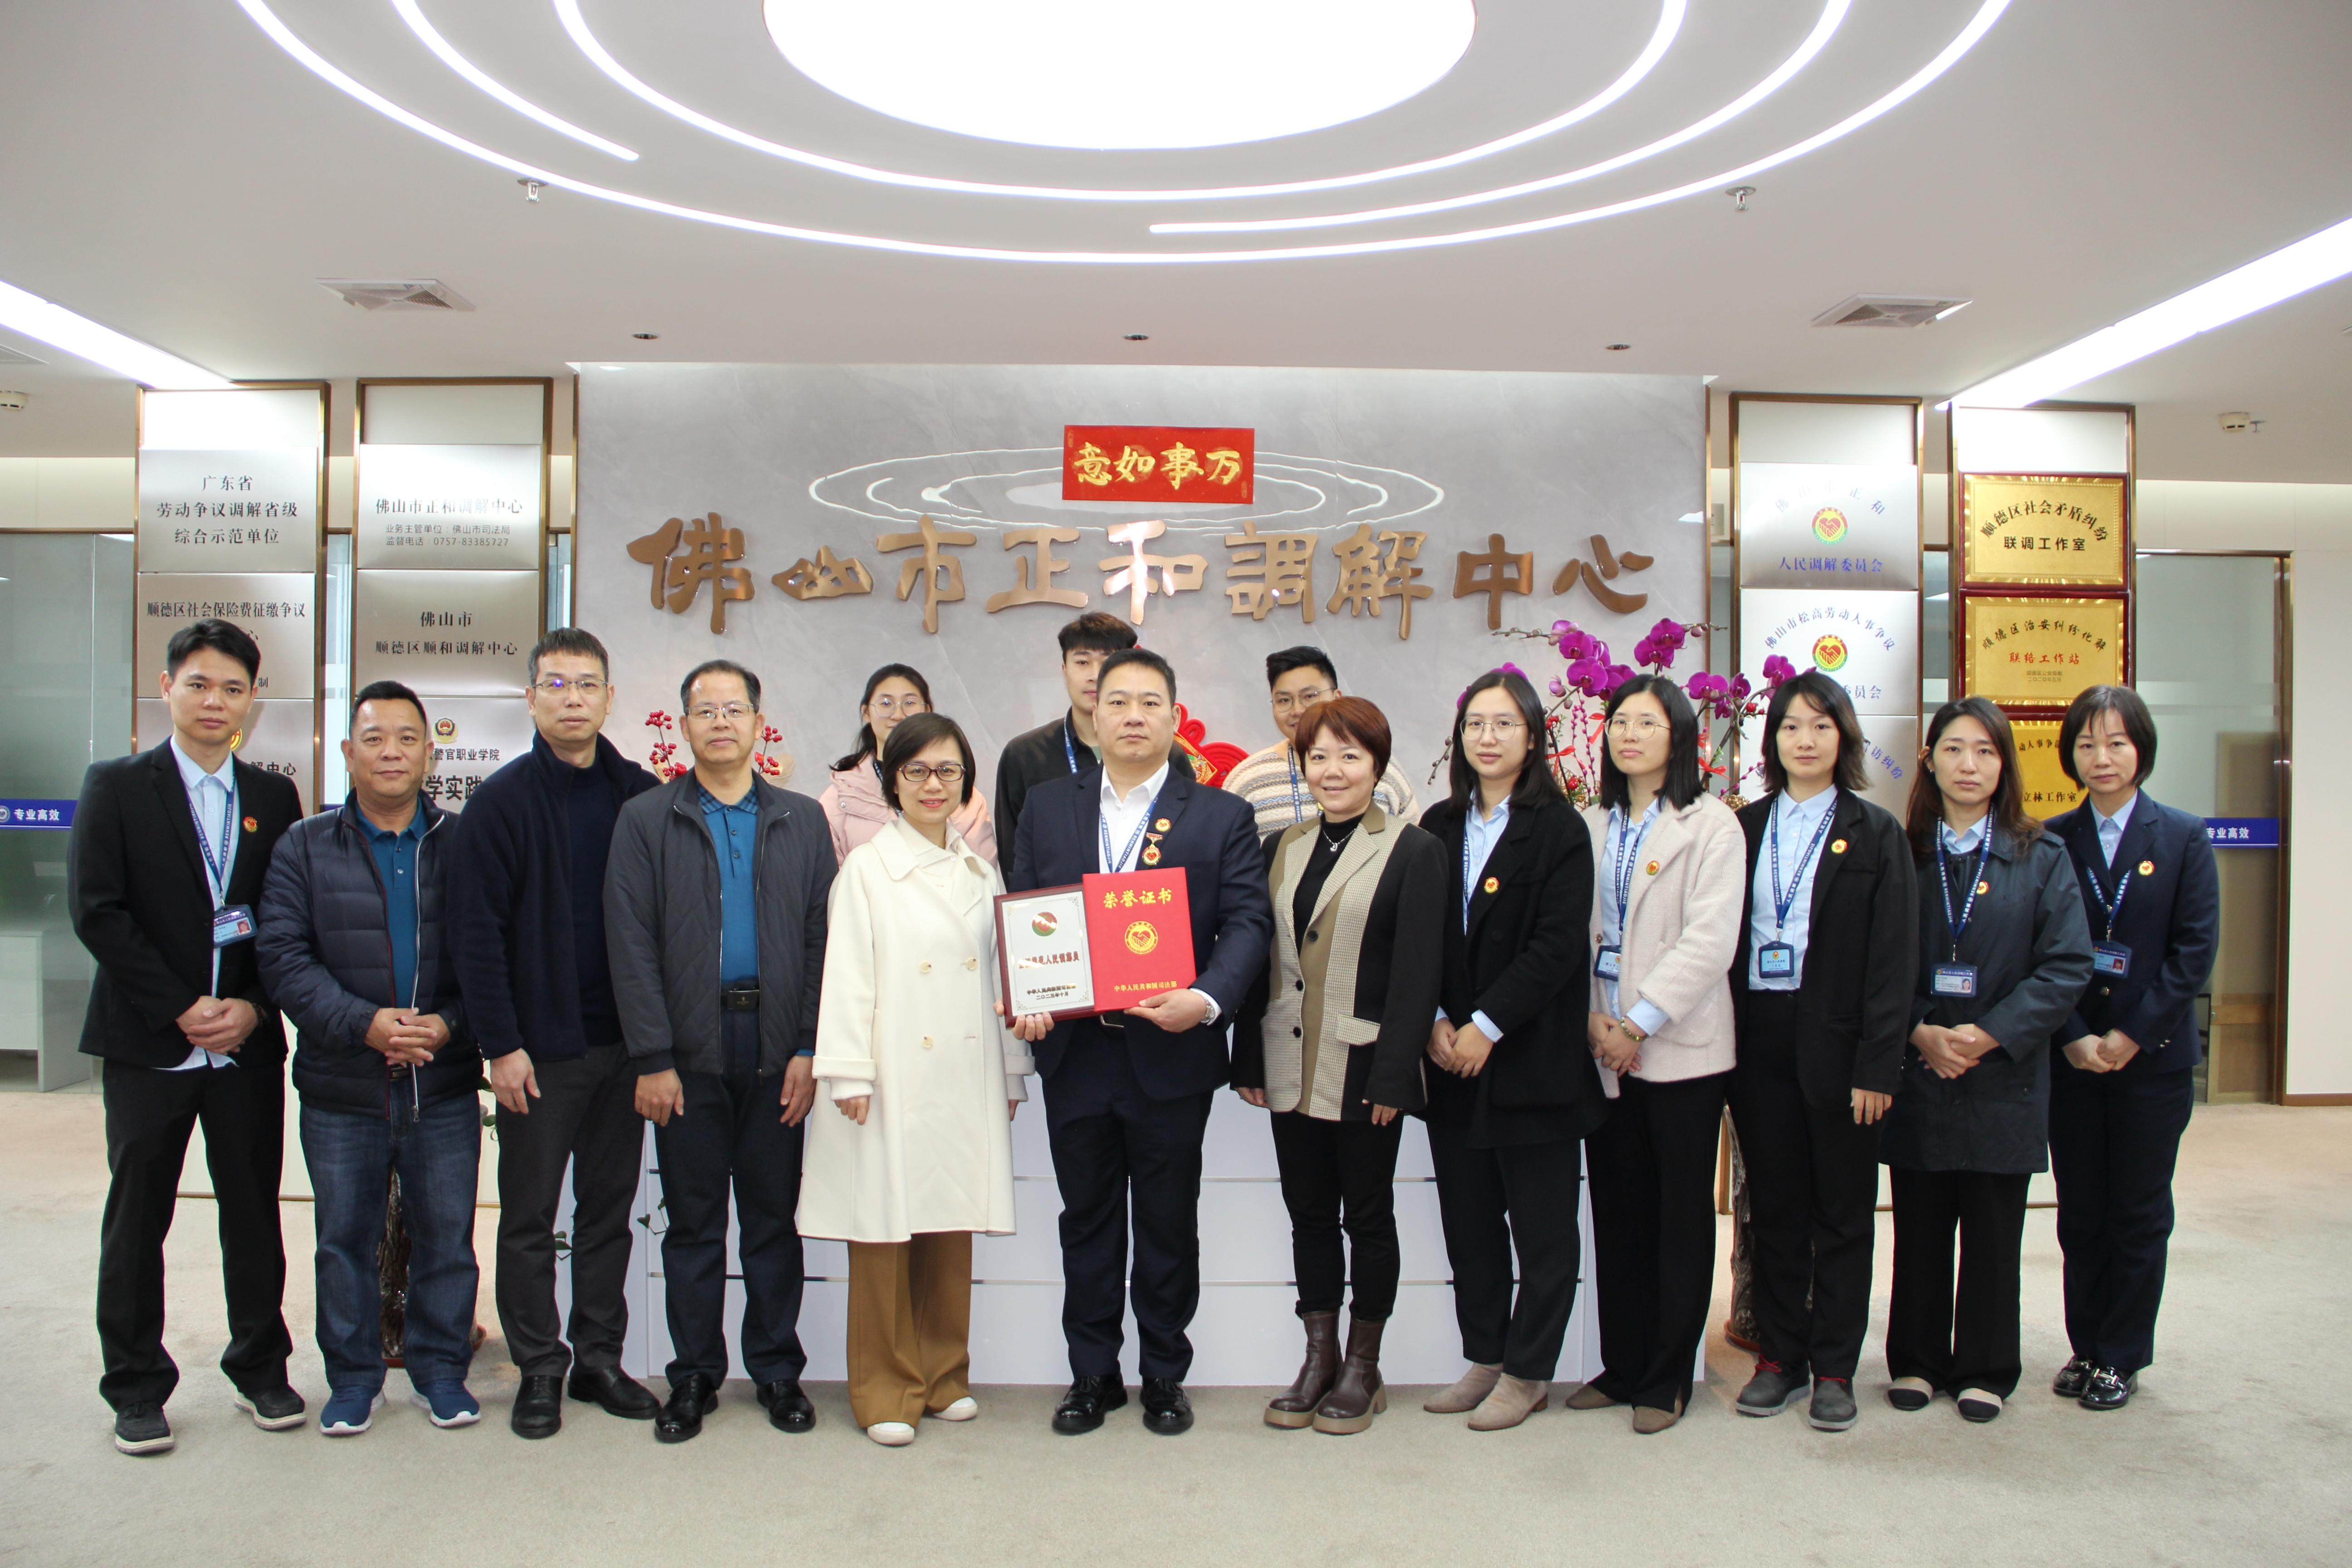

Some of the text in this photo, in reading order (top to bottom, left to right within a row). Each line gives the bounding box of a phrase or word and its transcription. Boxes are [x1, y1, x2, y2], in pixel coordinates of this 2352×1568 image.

[202, 475, 254, 491] 广东省
[157, 502, 298, 518] 劳动争议调解省级
[376, 498, 523, 514] 佛山市正和调解中心
[1980, 500, 2109, 541] 顺德区社会矛盾纠纷
[175, 528, 279, 544] 综合示范单位
[2004, 536, 2086, 551] 联调工作室
[1779, 556, 1883, 572] 人民调解委员会
[147, 601, 306, 617] 顺德区社会保险费征缴争议
[420, 611, 473, 627] 佛山市
[1764, 607, 1896, 651] 佛山市松高劳动人事争议
[1982, 619, 2107, 652] 顺德区治安纠纷化解
[376, 640, 518, 655] 顺德区顺和调解中心
[2009, 652, 2079, 665] 联络工作站
[430, 748, 500, 761] 警官职业学院
[2024, 791, 2077, 802] 立林工作室
[14, 808, 60, 821] 专业高效
[2206, 827, 2249, 838] 专业高效
[1103, 887, 1172, 908] 荣誉证书
[1114, 980, 1177, 992] 中华人民共和国司法部
